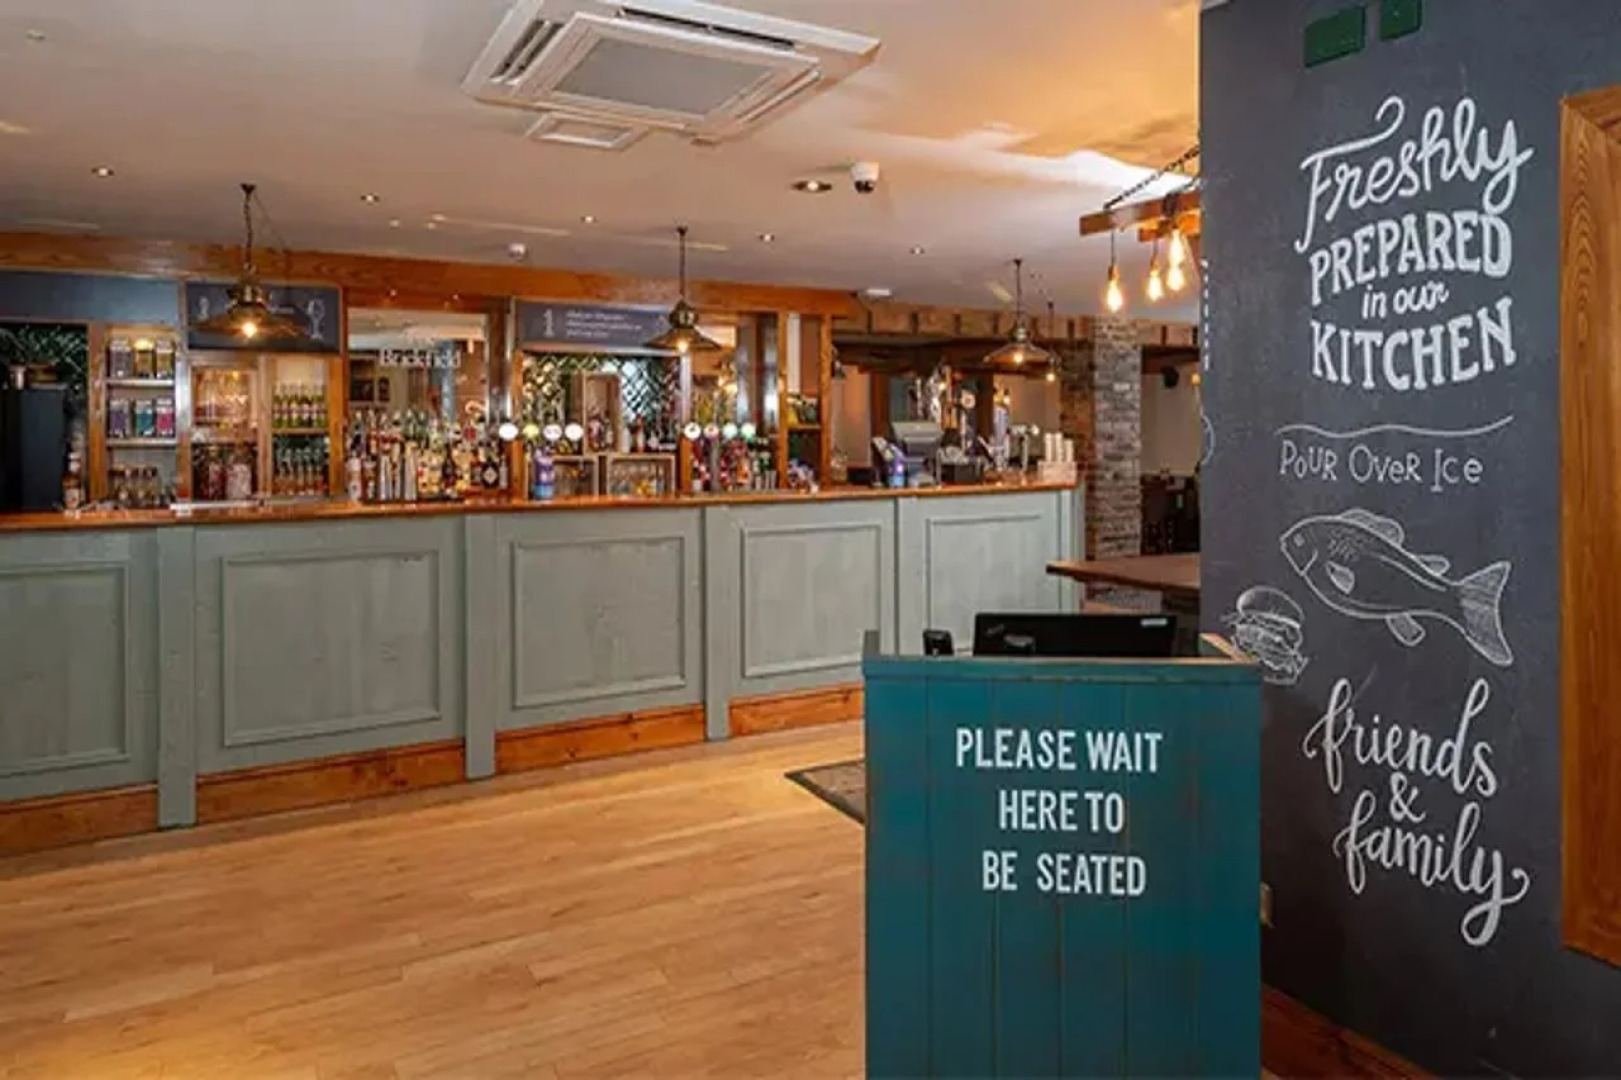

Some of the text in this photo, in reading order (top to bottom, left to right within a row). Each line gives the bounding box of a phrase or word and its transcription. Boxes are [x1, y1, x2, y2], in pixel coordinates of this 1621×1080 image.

[1294, 95, 1534, 253] Freshly
[1309, 210, 1513, 306] PREPARED
[1362, 280, 1449, 319] in our
[1309, 297, 1516, 391] KITCHEN
[955, 728, 1163, 773] PLEASE WAIT
[1303, 678, 1497, 796] friends
[998, 789, 1126, 834] HERE TO
[1389, 772, 1426, 822] &
[982, 850, 1147, 896] BE SEATED
[1332, 790, 1530, 946] family
